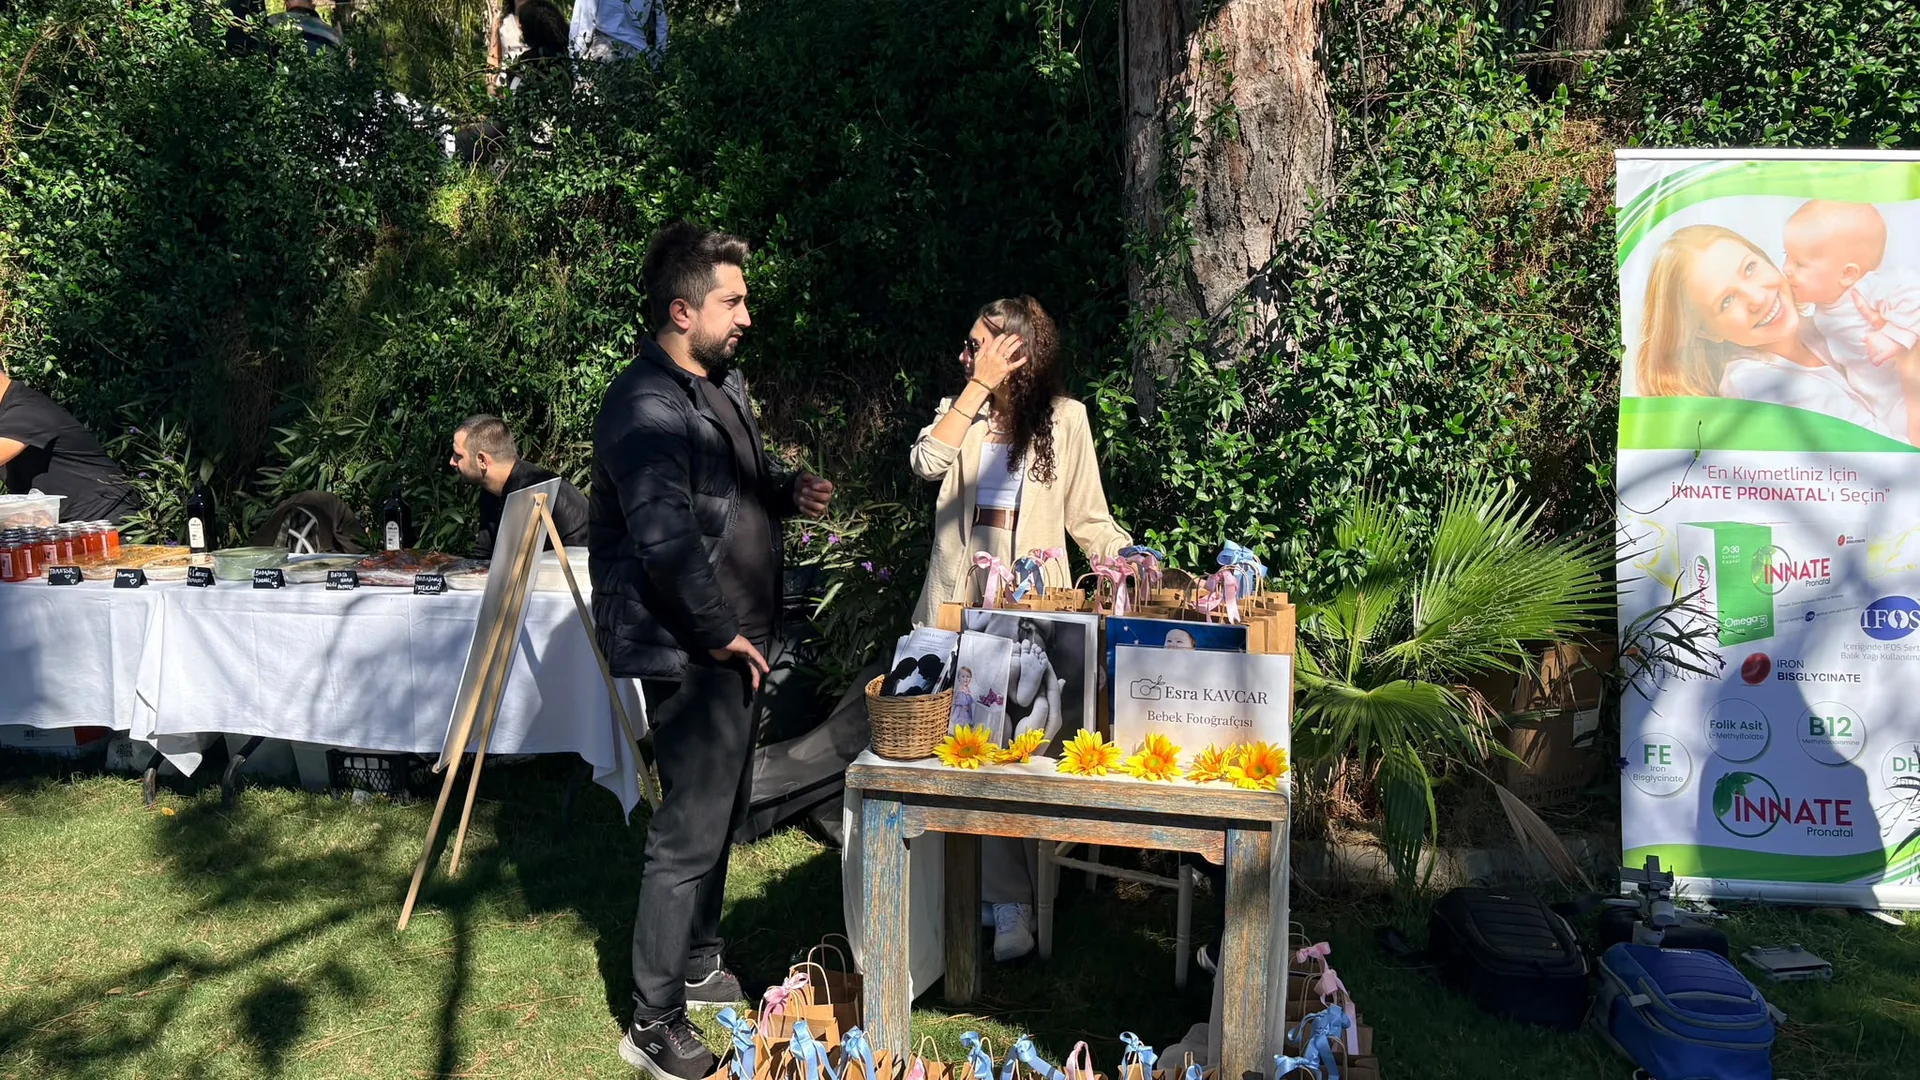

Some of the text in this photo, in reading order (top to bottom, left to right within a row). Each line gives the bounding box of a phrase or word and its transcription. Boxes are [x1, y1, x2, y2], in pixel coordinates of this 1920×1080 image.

[1733, 466, 1823, 484] Kıymetliniz
[1829, 464, 1857, 484] İçin
[1805, 578, 1831, 587] Pronatal
[1862, 608, 1920, 630] IFOS
[1884, 643, 1902, 652] IFOS
[1776, 659, 1805, 669] IRON
[1777, 672, 1861, 683] BISGLYCINATE
[1165, 686, 1268, 704] Esra KAVCAR
[1147, 710, 1253, 729] Bebek Fotoğrafçısı
[1709, 719, 1763, 731] Folik Asit
[1808, 716, 1853, 737] B12
[1708, 732, 1765, 742] L-Methylfolate
[1643, 744, 1672, 765] FE
[1650, 765, 1667, 773] Iron
[1632, 773, 1684, 784] Bisglycinate
[1806, 826, 1854, 838] Pronatal
